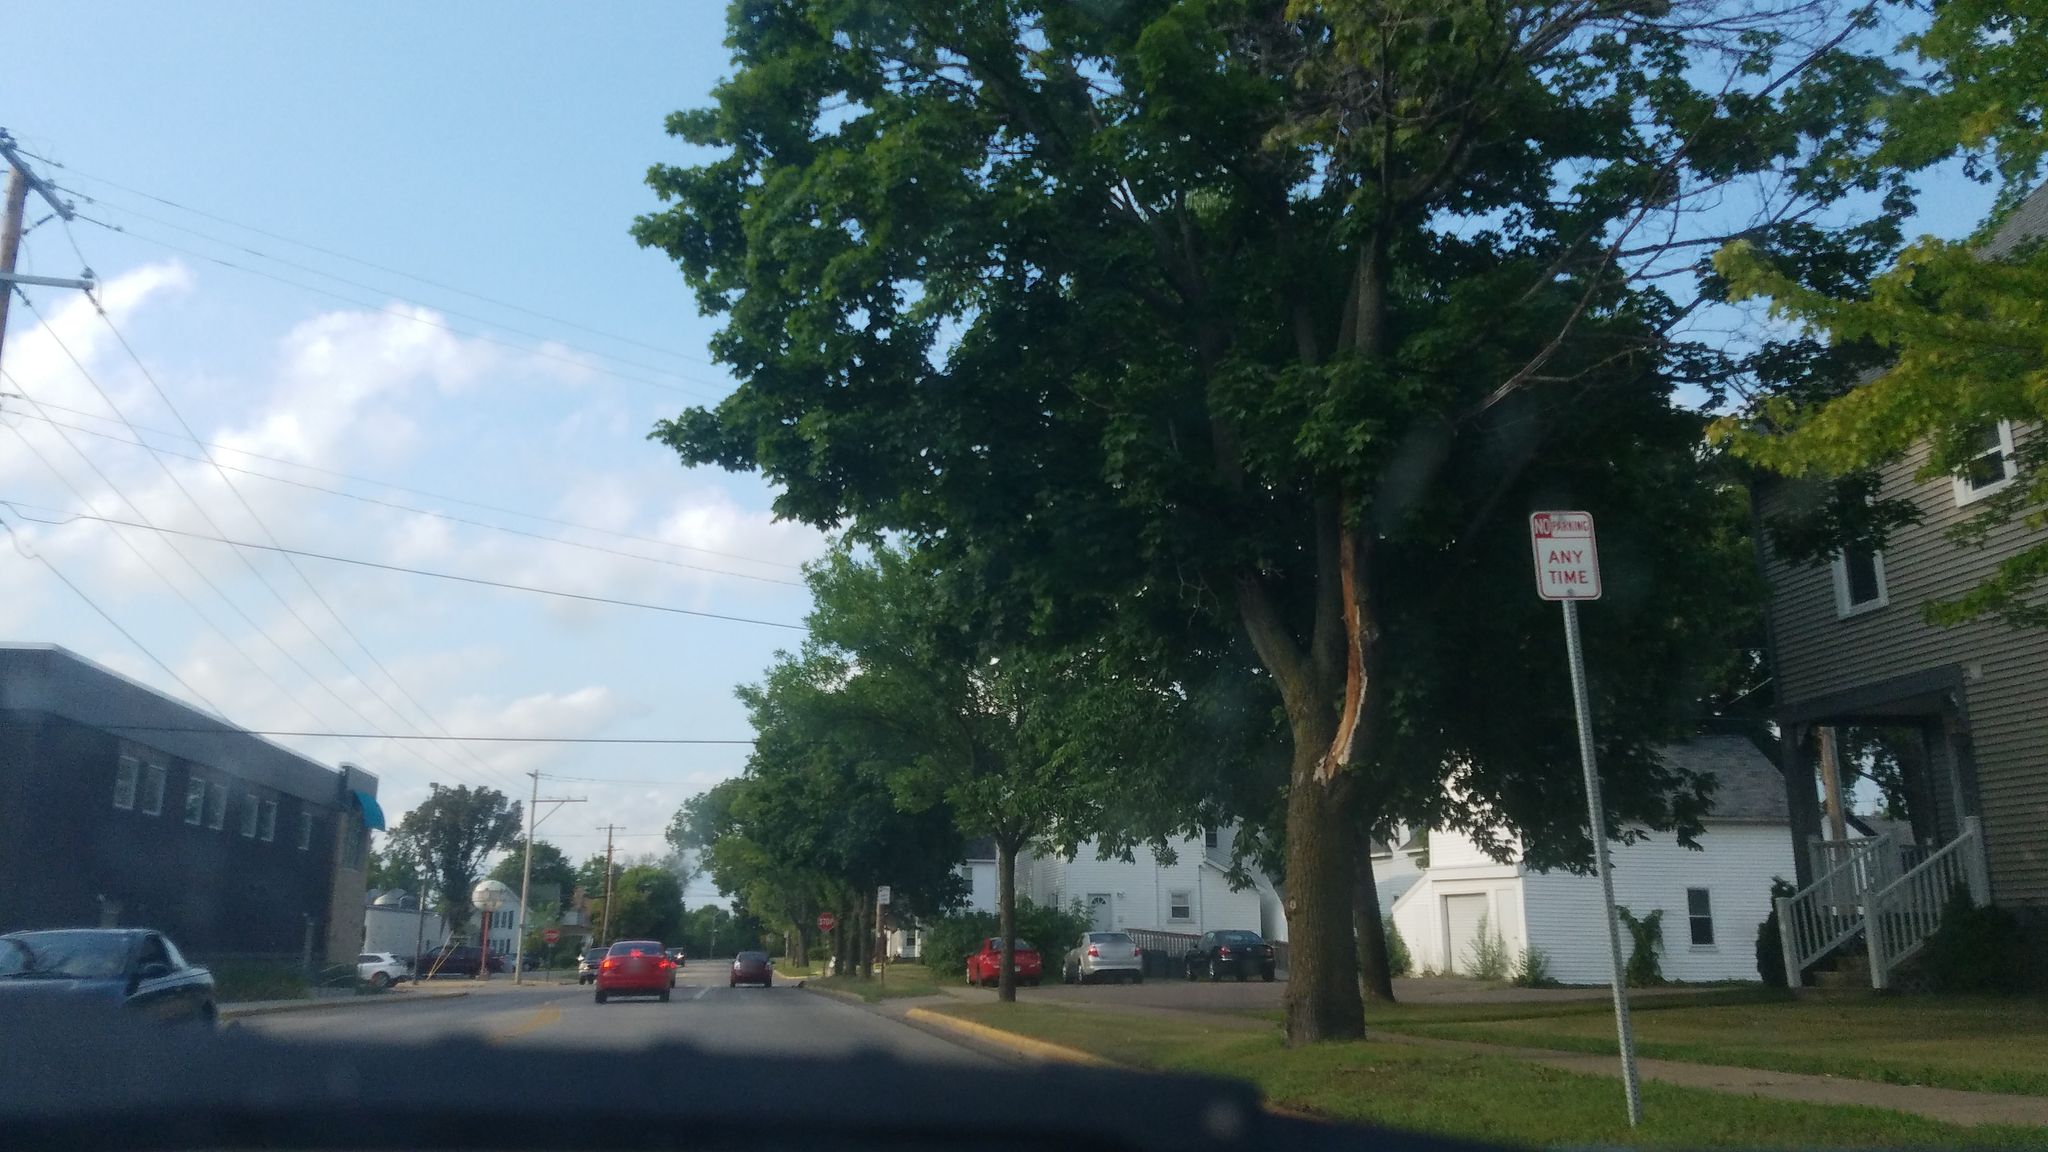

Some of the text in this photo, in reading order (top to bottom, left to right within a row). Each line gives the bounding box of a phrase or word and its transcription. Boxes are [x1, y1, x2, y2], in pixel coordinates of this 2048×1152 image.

[1535, 518, 1551, 534] NO
[1549, 550, 1583, 564] ANY
[1549, 570, 1589, 584] TIME
